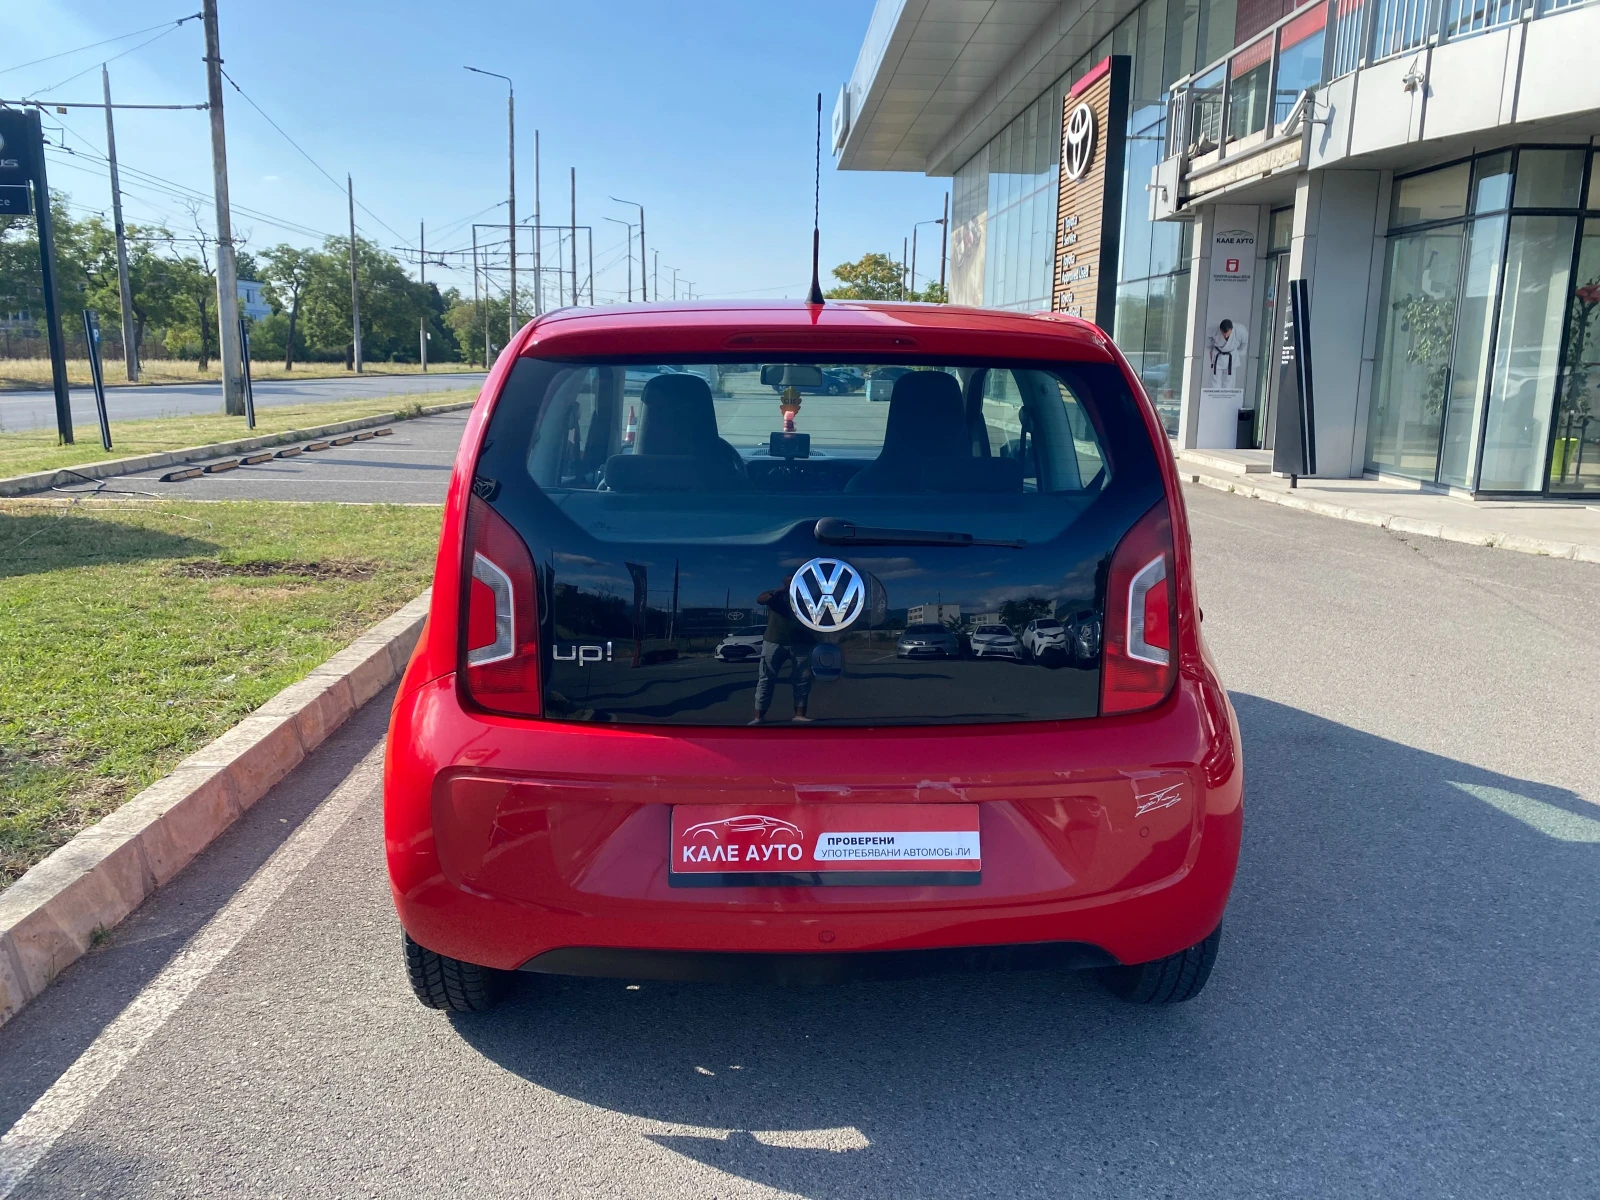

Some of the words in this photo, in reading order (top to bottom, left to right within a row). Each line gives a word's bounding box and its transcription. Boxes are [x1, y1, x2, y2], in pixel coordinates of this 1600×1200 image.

[553, 641, 612, 667] up!
[827, 837, 895, 846] ПРОВЕРЕНИ
[682, 845, 740, 863] КАЛЕ
[745, 843, 803, 862] АУТО
[821, 848, 901, 858] УПОТРЕБЯВАНИ
